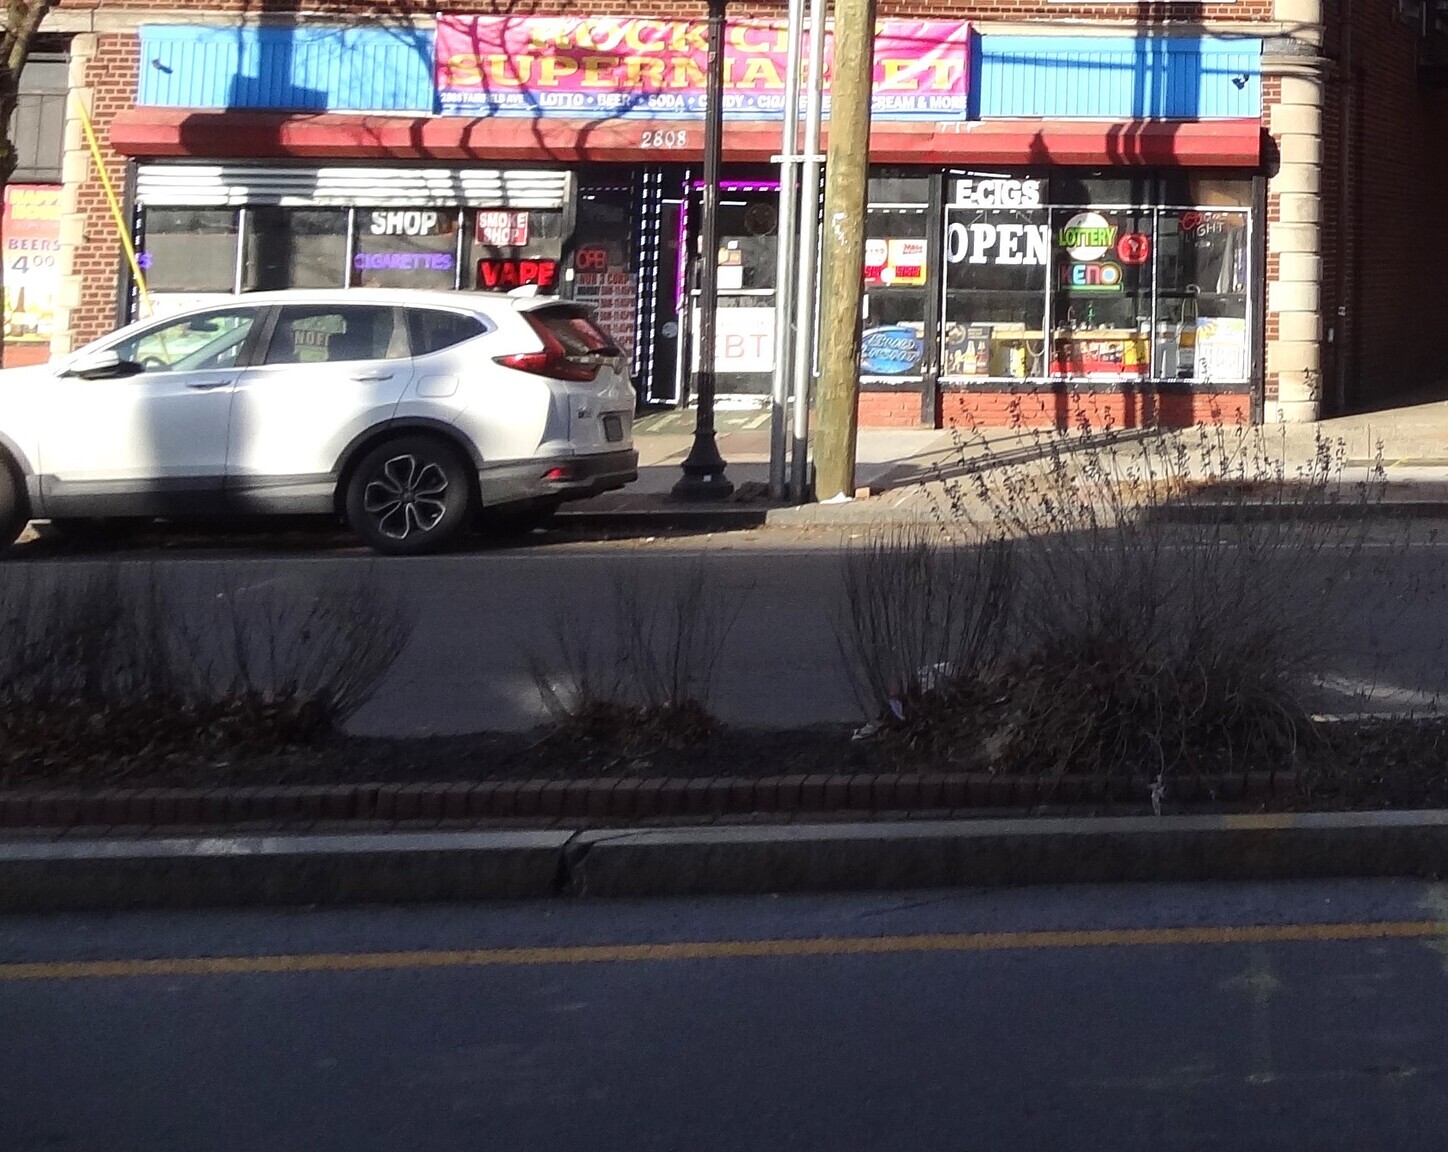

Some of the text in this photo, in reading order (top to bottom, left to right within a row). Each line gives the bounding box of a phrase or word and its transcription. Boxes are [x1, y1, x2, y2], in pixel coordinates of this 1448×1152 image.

[539, 93, 584, 107] LOTTO
[597, 93, 631, 107] BEER
[648, 93, 685, 108] SODA
[640, 129, 687, 150] 2808
[955, 179, 1041, 205] E-CIGS
[370, 210, 437, 236] SHOP
[479, 212, 527, 229] SMOKE
[8, 238, 61, 251] BEERS
[483, 228, 520, 243] SHOP
[946, 222, 1049, 266] OPEN
[1058, 226, 1117, 248] LOTTERY
[354, 252, 454, 271] CIGARETTES
[481, 261, 557, 287] VAPE
[715, 333, 769, 359] BT
